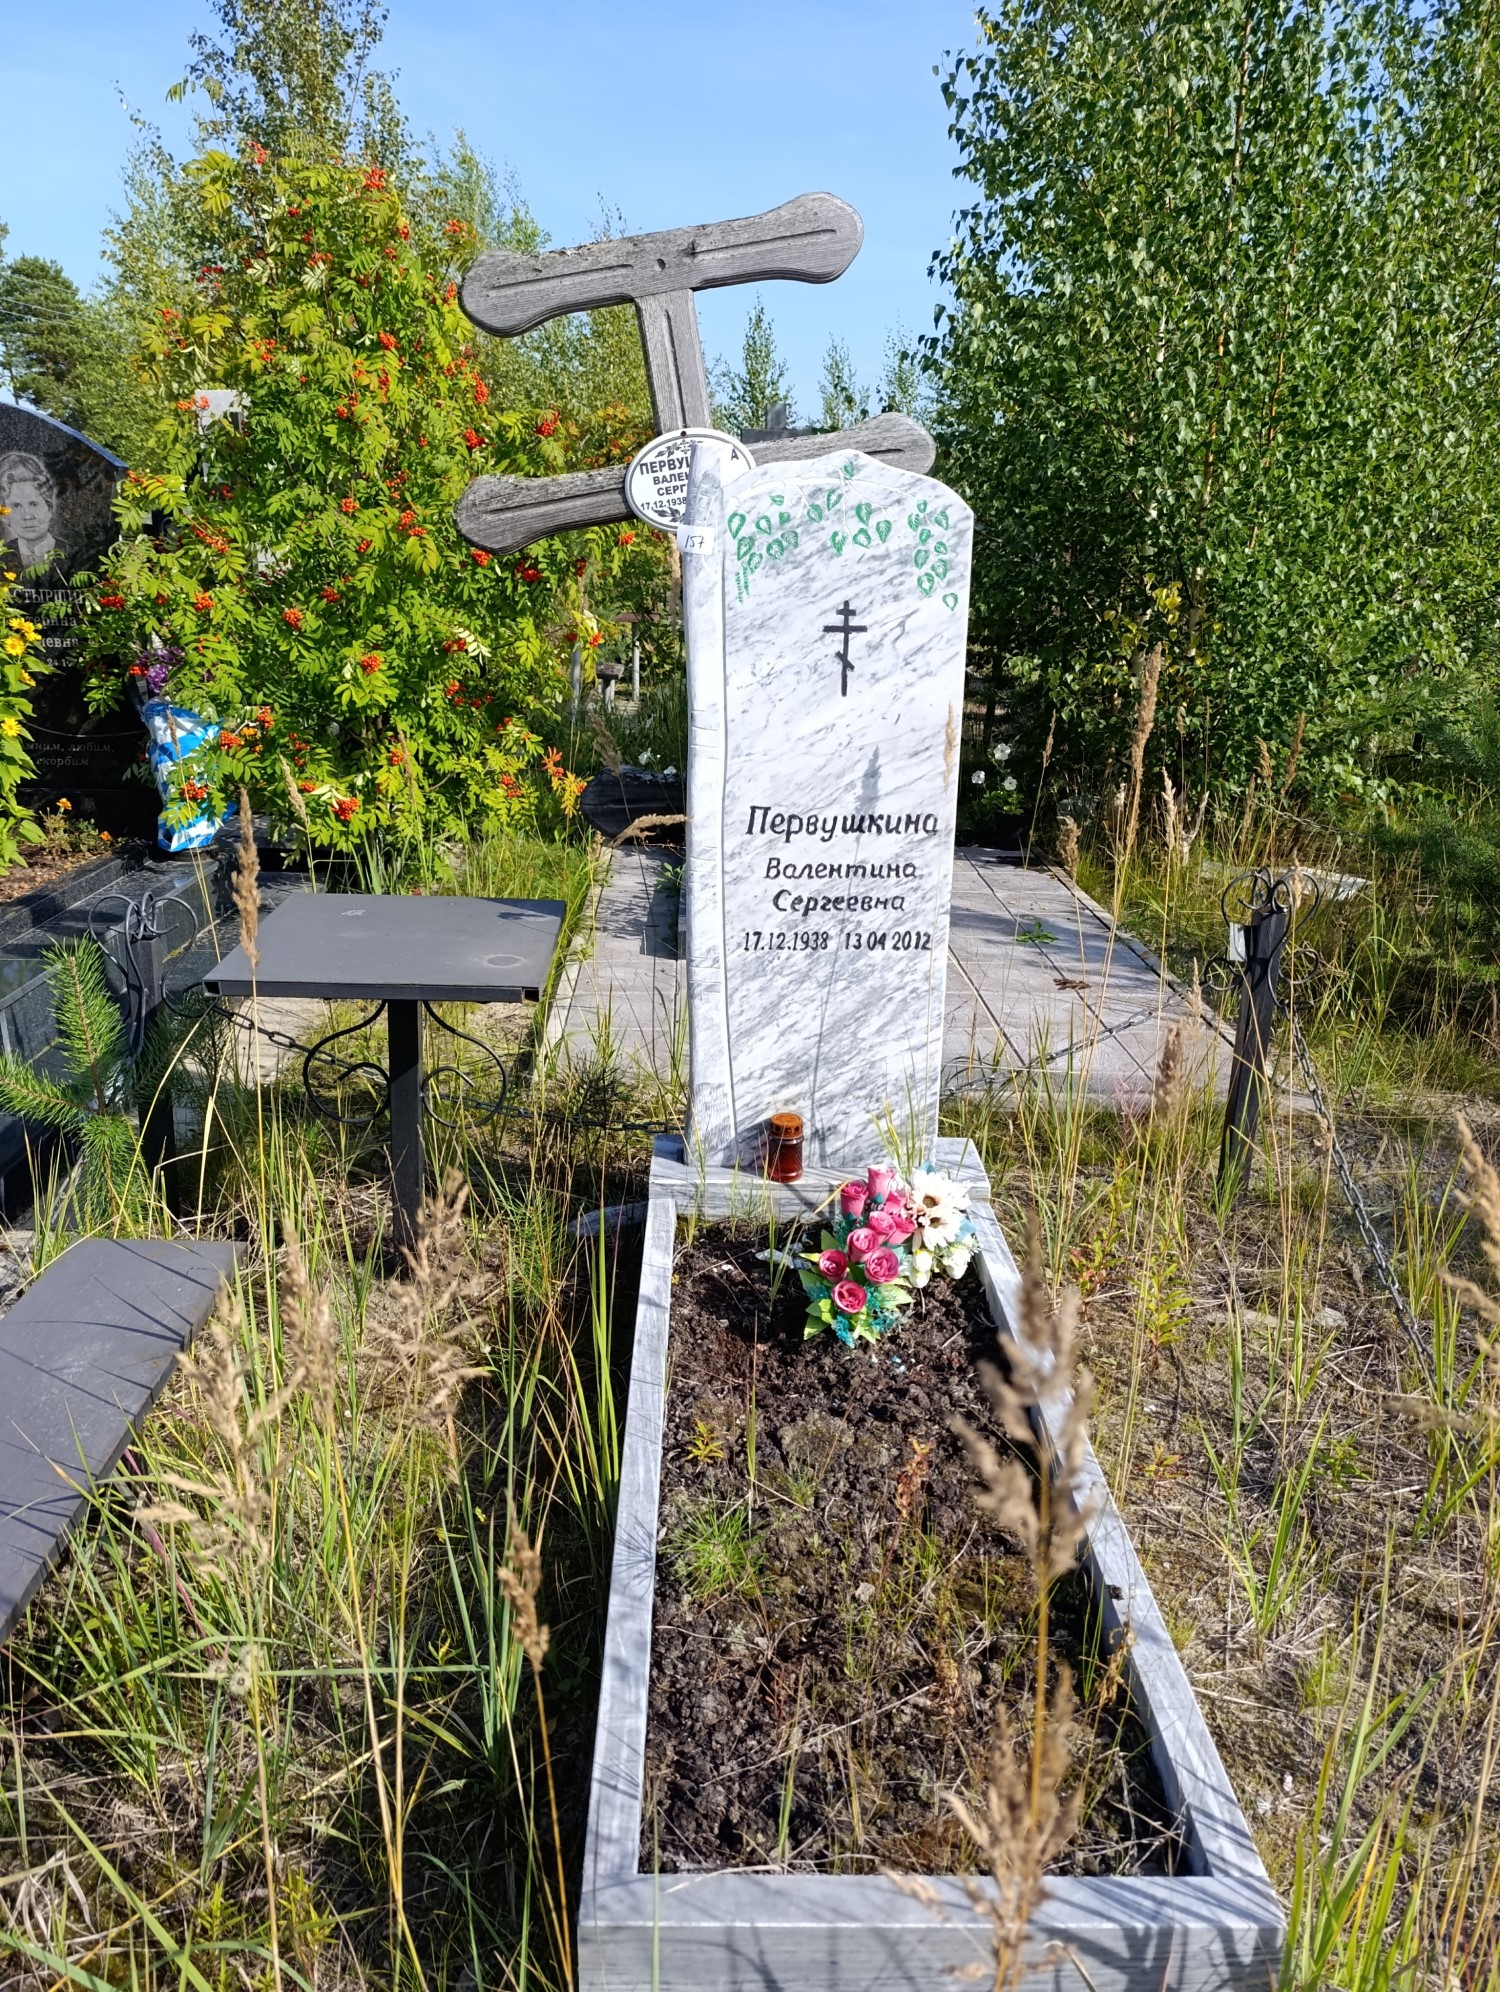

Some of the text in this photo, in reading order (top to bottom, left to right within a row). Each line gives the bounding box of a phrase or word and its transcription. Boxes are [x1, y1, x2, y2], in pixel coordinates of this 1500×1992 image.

[684, 535, 705, 548] 157
[42, 637, 79, 648] евна
[24, 742, 64, 753] мним,
[745, 805, 939, 843] Первушкина
[763, 857, 918, 880] Валентина
[772, 889, 906, 917] Сергеевна
[743, 931, 830, 951] 17.12.1938
